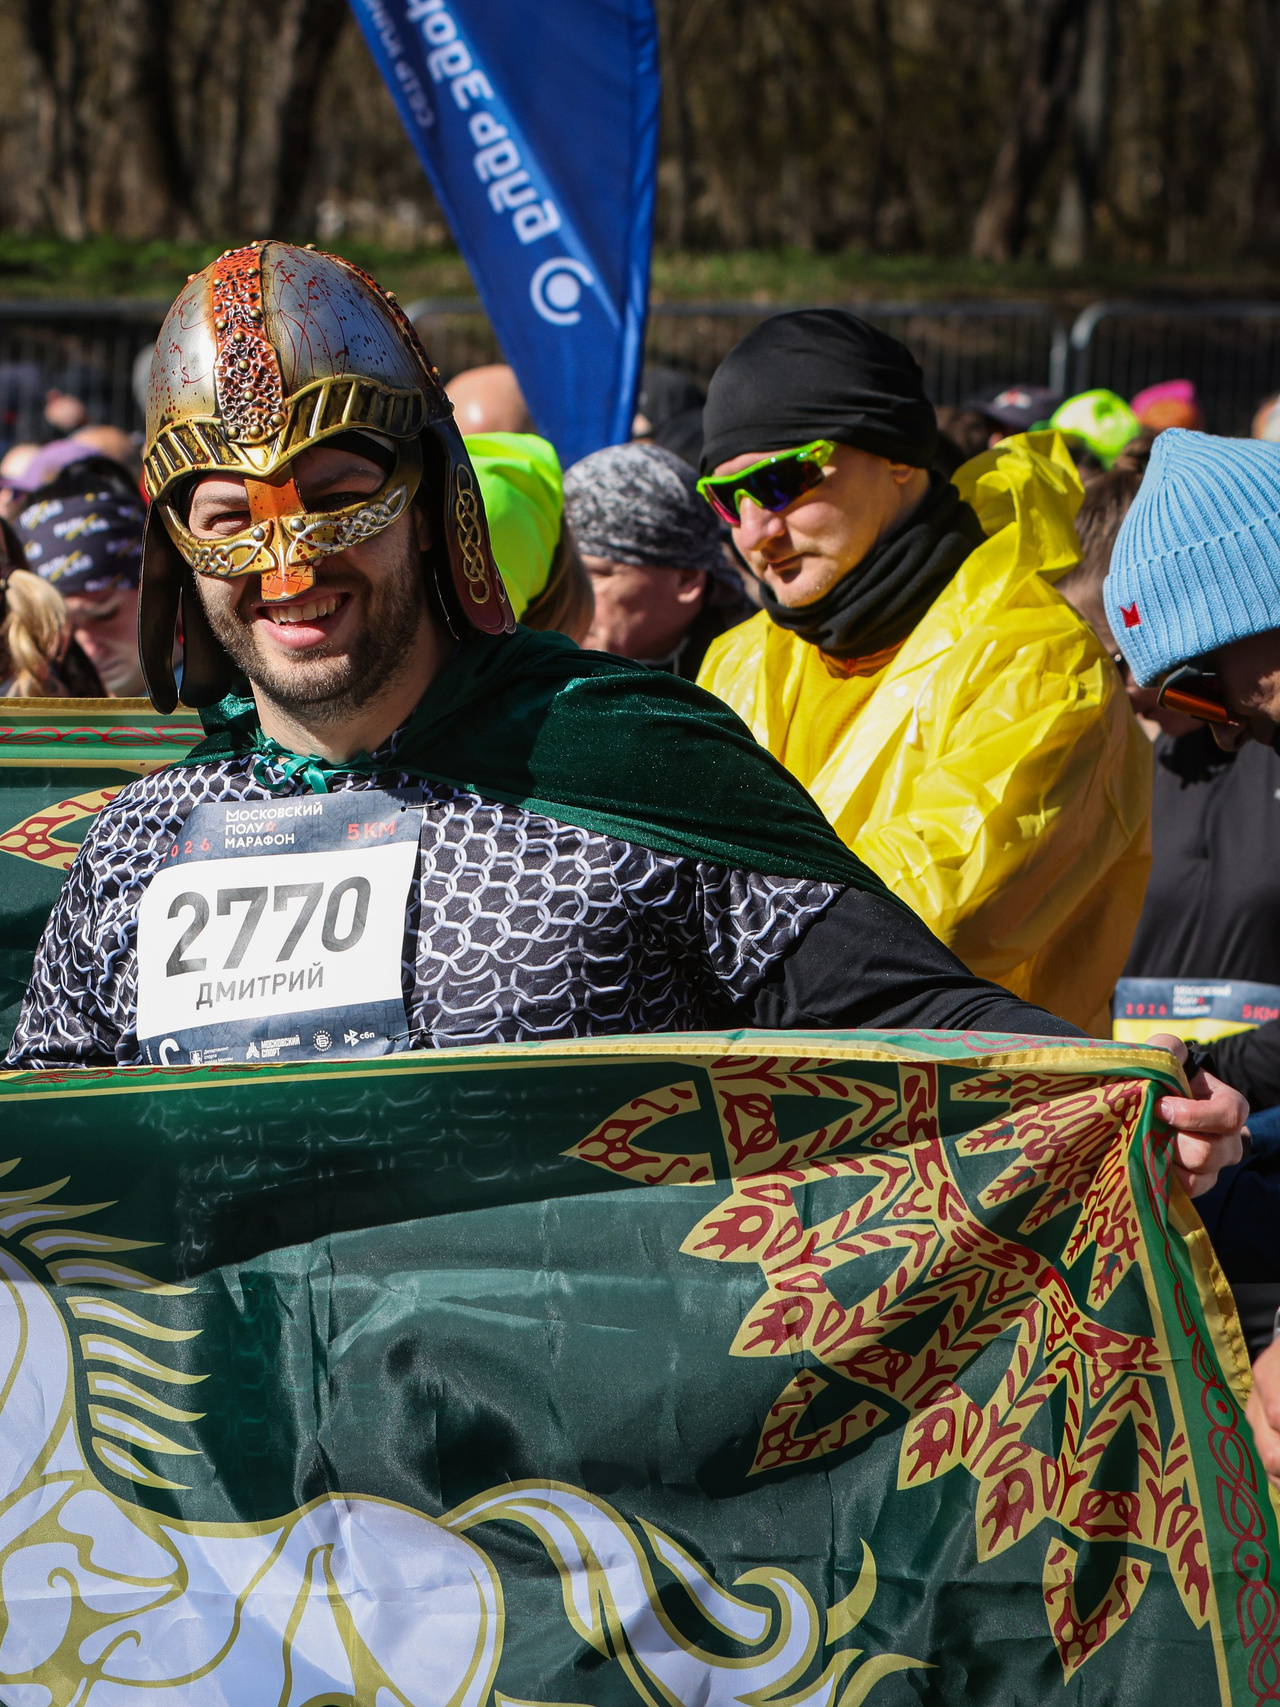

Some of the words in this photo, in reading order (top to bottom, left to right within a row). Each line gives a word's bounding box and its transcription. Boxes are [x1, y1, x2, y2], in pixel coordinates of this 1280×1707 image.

[225, 823, 264, 836] ПОЛУ
[225, 834, 295, 849] МАРАФОН
[166, 875, 372, 978] 2770
[195, 962, 325, 1011] ДМИТРИЙ
[261, 1035, 300, 1049] МОСКОВСКИЙ
[261, 1047, 281, 1059] СПОРТ
